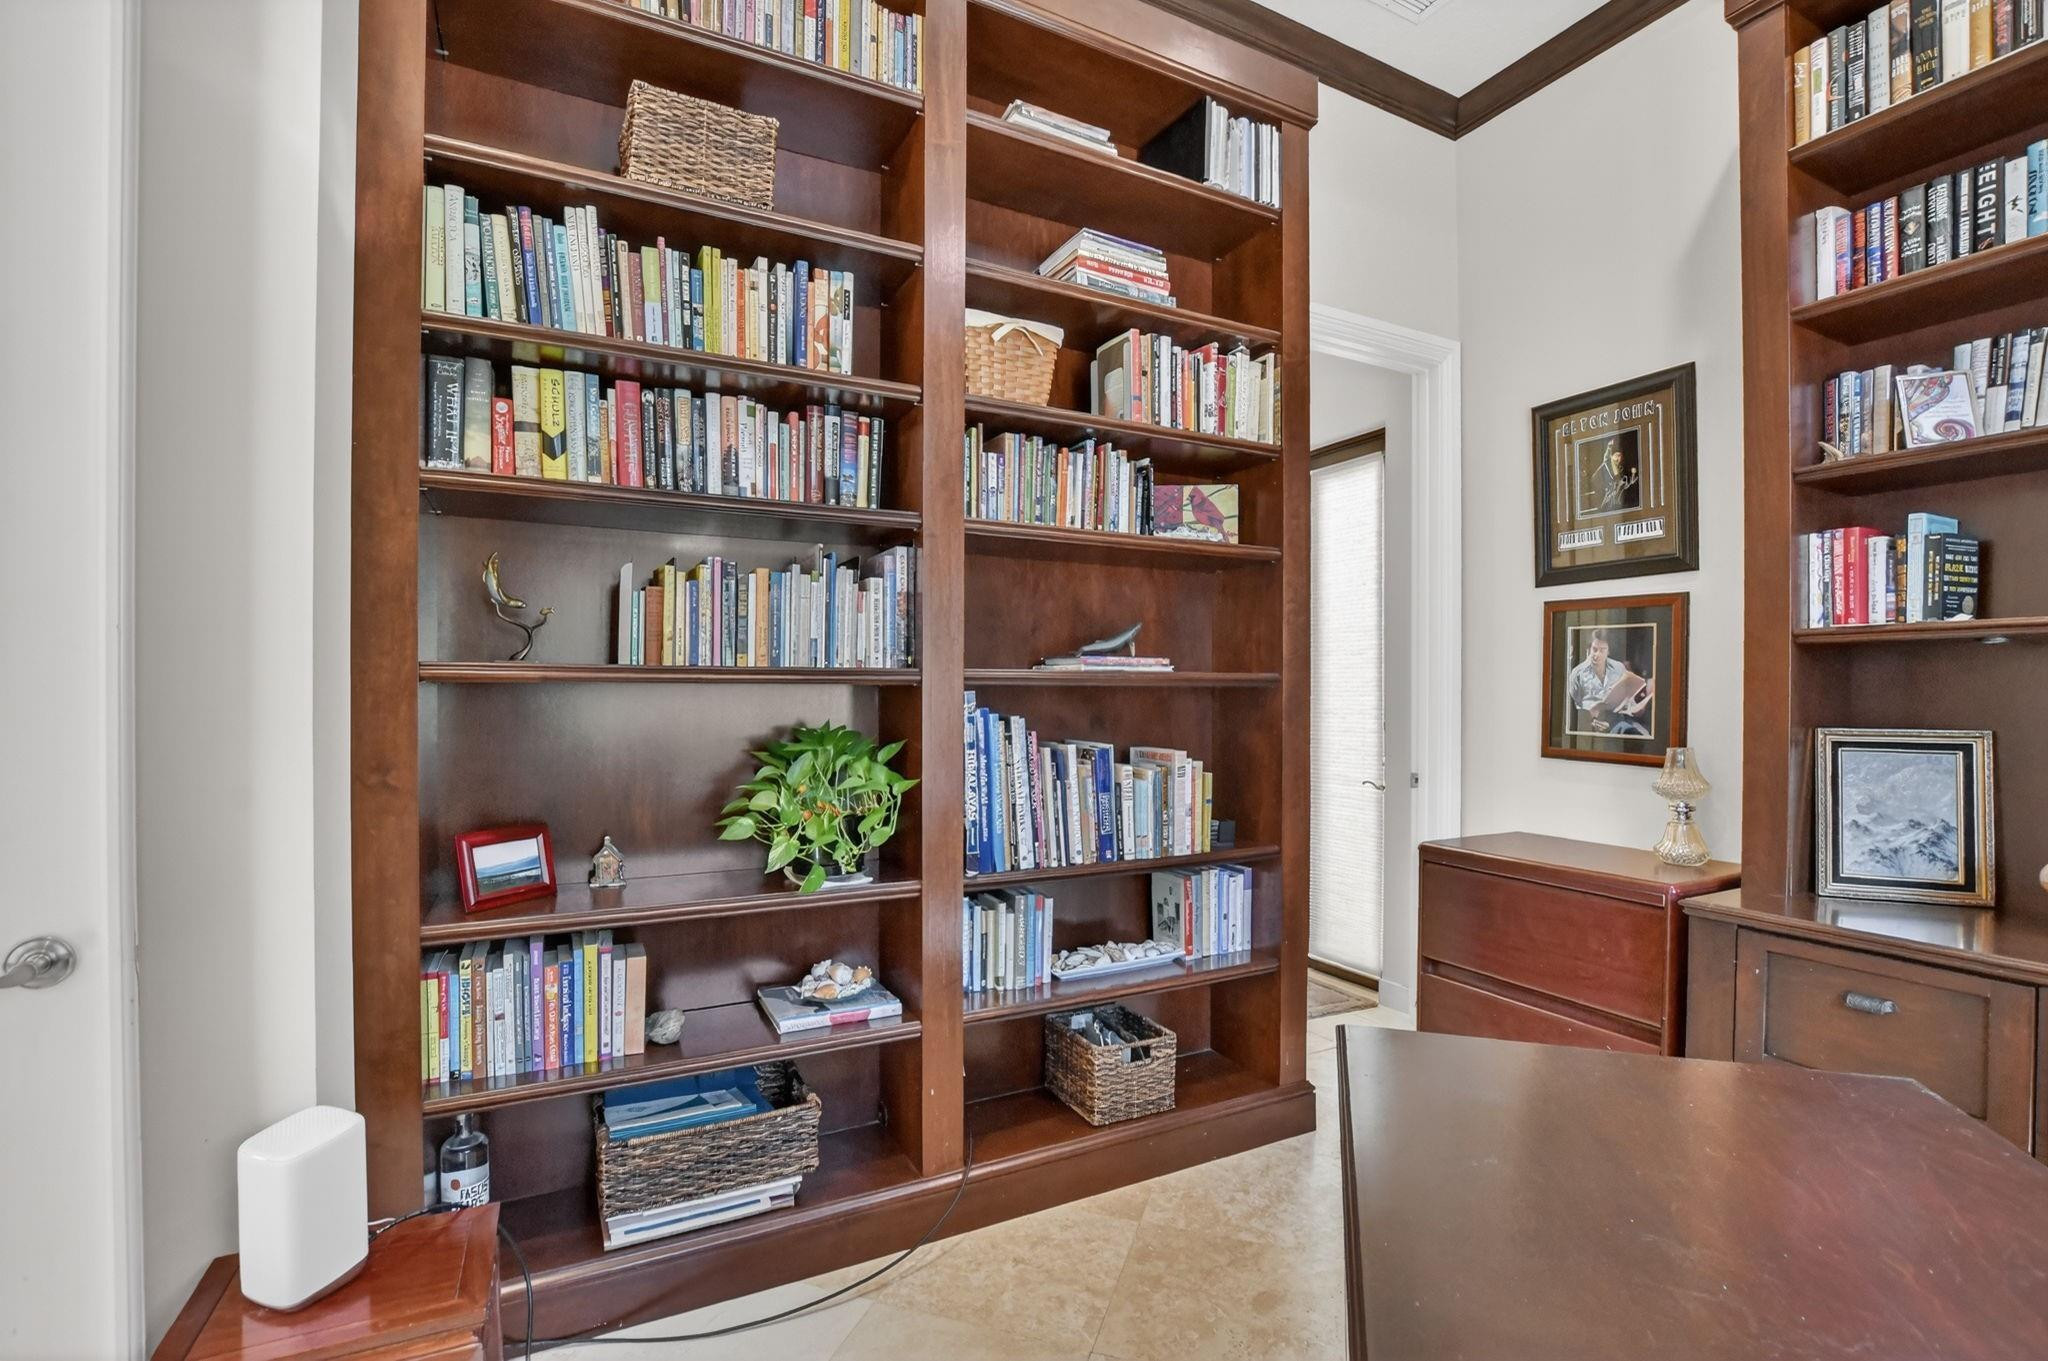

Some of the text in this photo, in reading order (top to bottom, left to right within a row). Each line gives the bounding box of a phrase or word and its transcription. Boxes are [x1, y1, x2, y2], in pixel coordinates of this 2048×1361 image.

[446, 382, 459, 421] WHAT
[551, 378, 560, 427] SCHULZ
[1562, 400, 1655, 437] ELTON JOHN
[967, 752, 977, 821] HIMALAYAS
